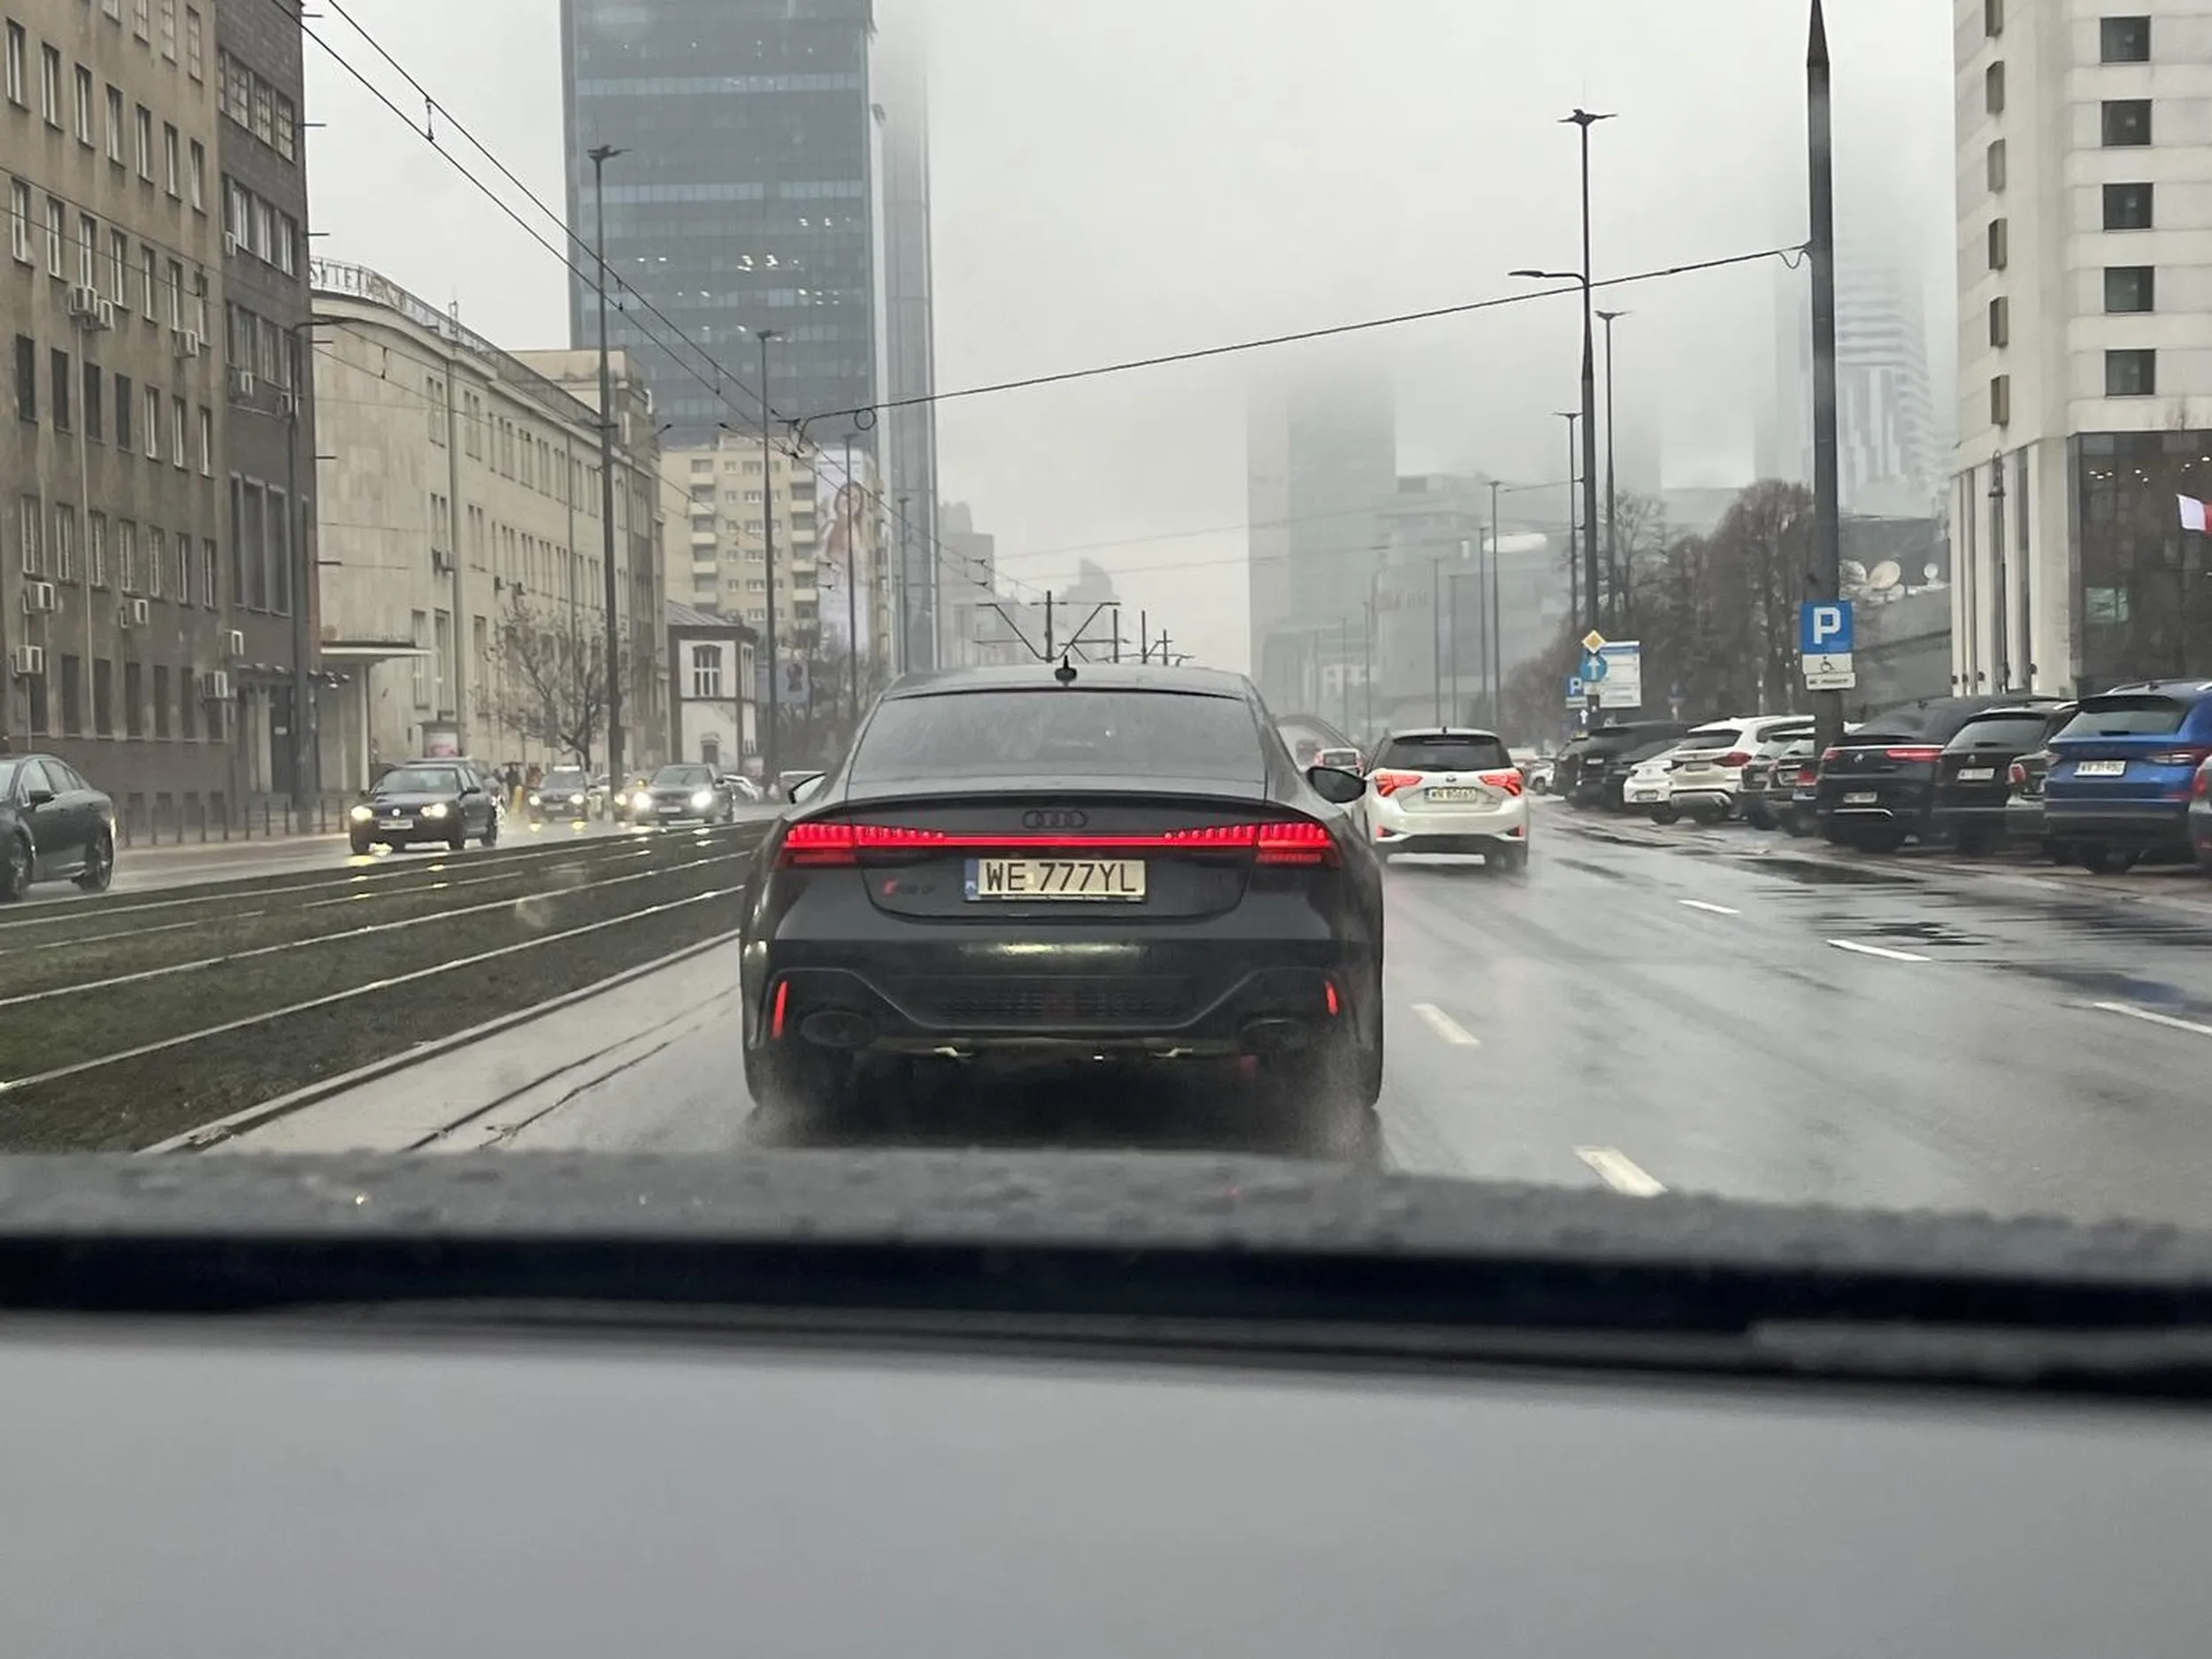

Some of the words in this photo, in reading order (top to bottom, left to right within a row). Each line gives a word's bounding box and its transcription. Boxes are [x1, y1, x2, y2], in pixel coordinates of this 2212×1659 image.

[1813, 607, 1841, 644] P
[1570, 677, 1583, 695] P
[986, 862, 1026, 892] WE
[1039, 863, 1137, 893] 777YL
